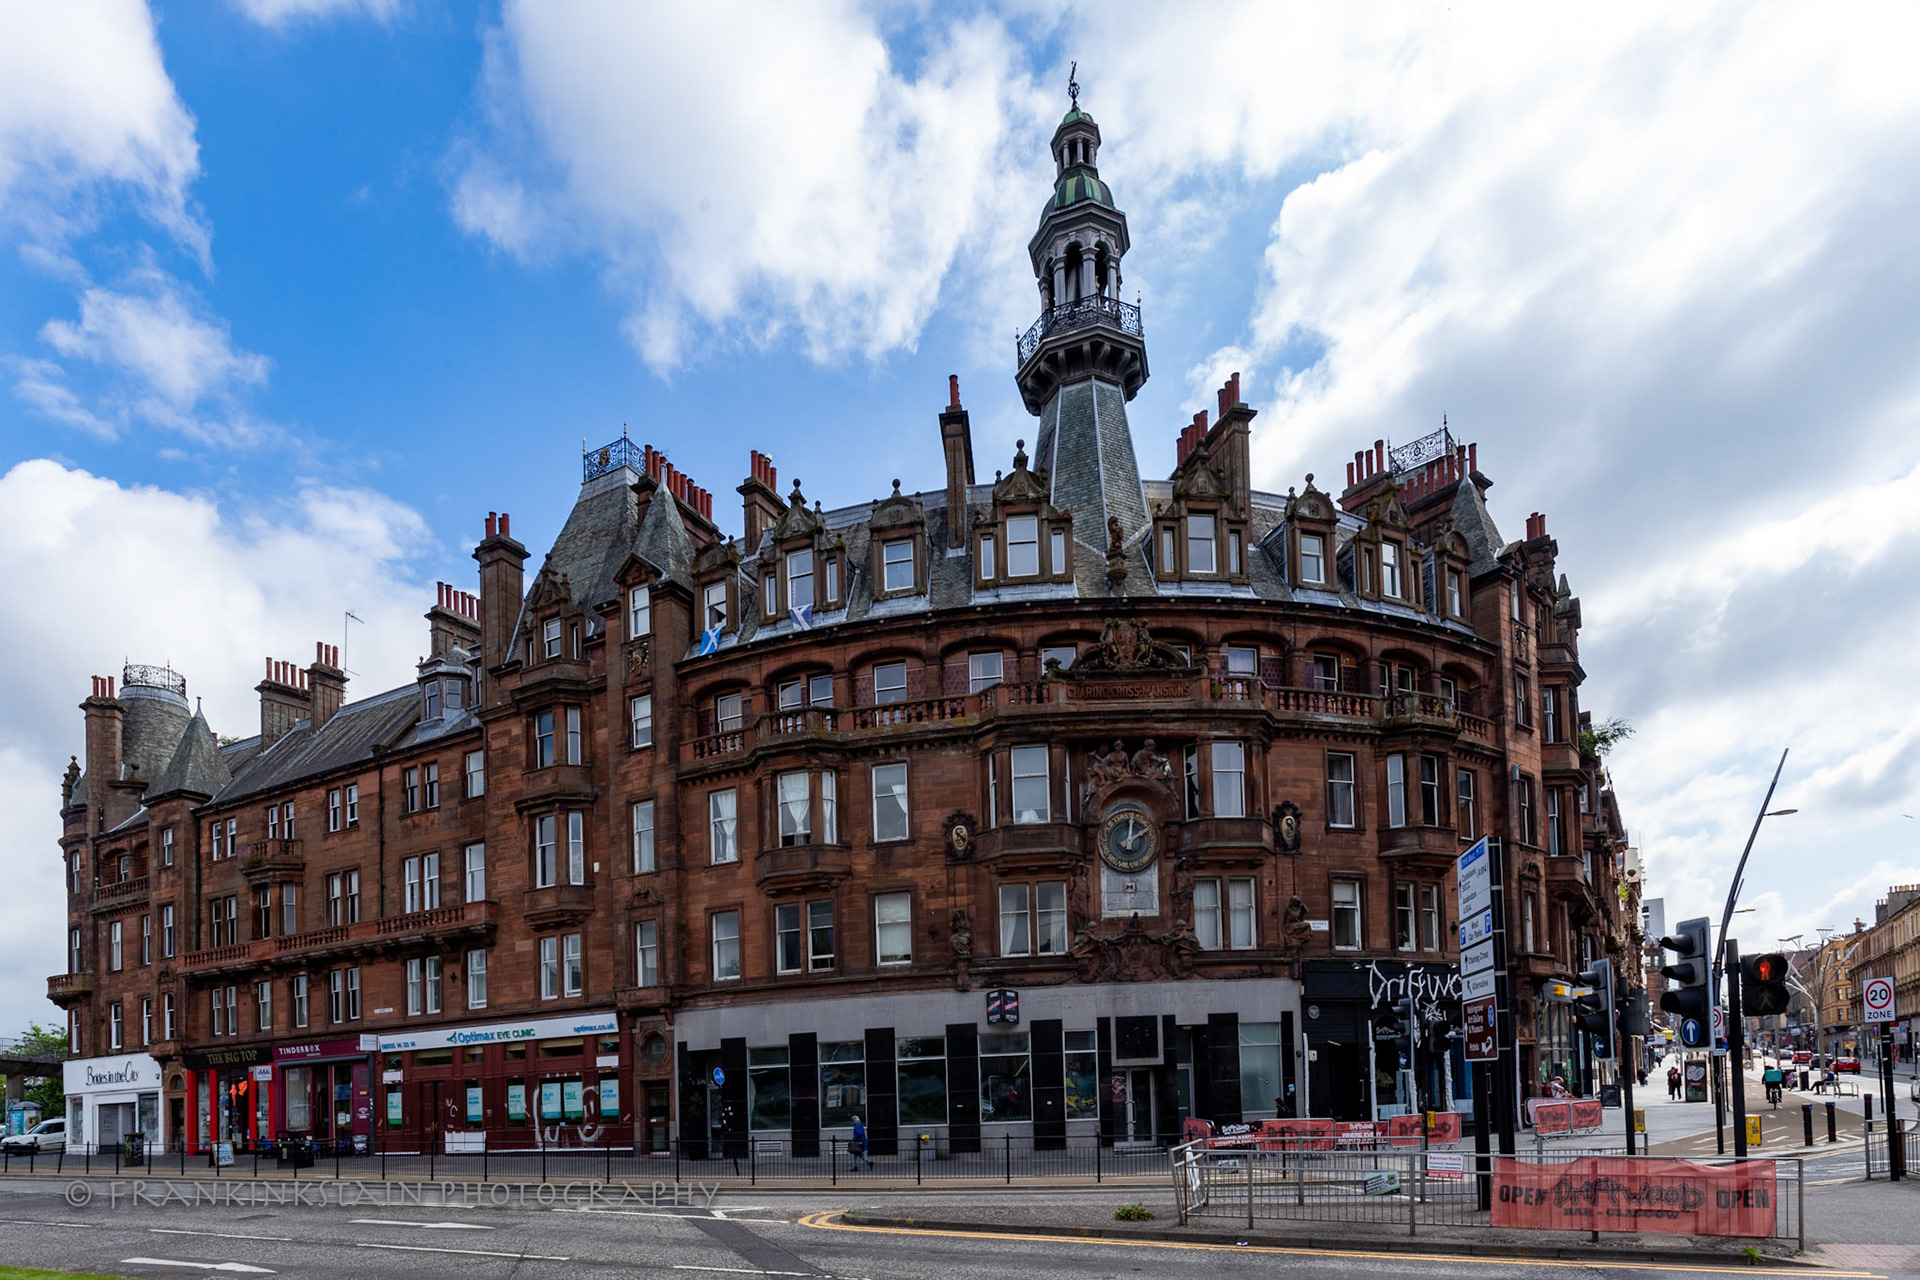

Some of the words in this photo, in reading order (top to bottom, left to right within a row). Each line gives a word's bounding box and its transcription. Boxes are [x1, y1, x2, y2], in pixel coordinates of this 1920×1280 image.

[1110, 685, 1140, 699] CROSS
[1142, 683, 1190, 698] MANSIONS
[1480, 951, 1489, 961] Cross
[1365, 960, 1462, 1010] Driftwo
[1869, 988, 1888, 1001] 20
[1867, 1010, 1892, 1019] ZONE
[457, 1031, 495, 1044] Optimax
[497, 1031, 511, 1040] EYE
[512, 1028, 536, 1038] CLINIC
[573, 1023, 615, 1034] optimax.co.uk
[206, 1053, 223, 1065] THE
[224, 1051, 240, 1064] BIG
[241, 1050, 258, 1062] TOP
[278, 1044, 321, 1056] TINDERBOX
[85, 1065, 108, 1087] Brides
[124, 1060, 140, 1084] City
[1500, 1184, 1548, 1206] OPEN
[1715, 1188, 1770, 1209] OPEN
[1563, 1207, 1593, 1217] BAR
[1606, 1208, 1680, 1220] GLASGOW
